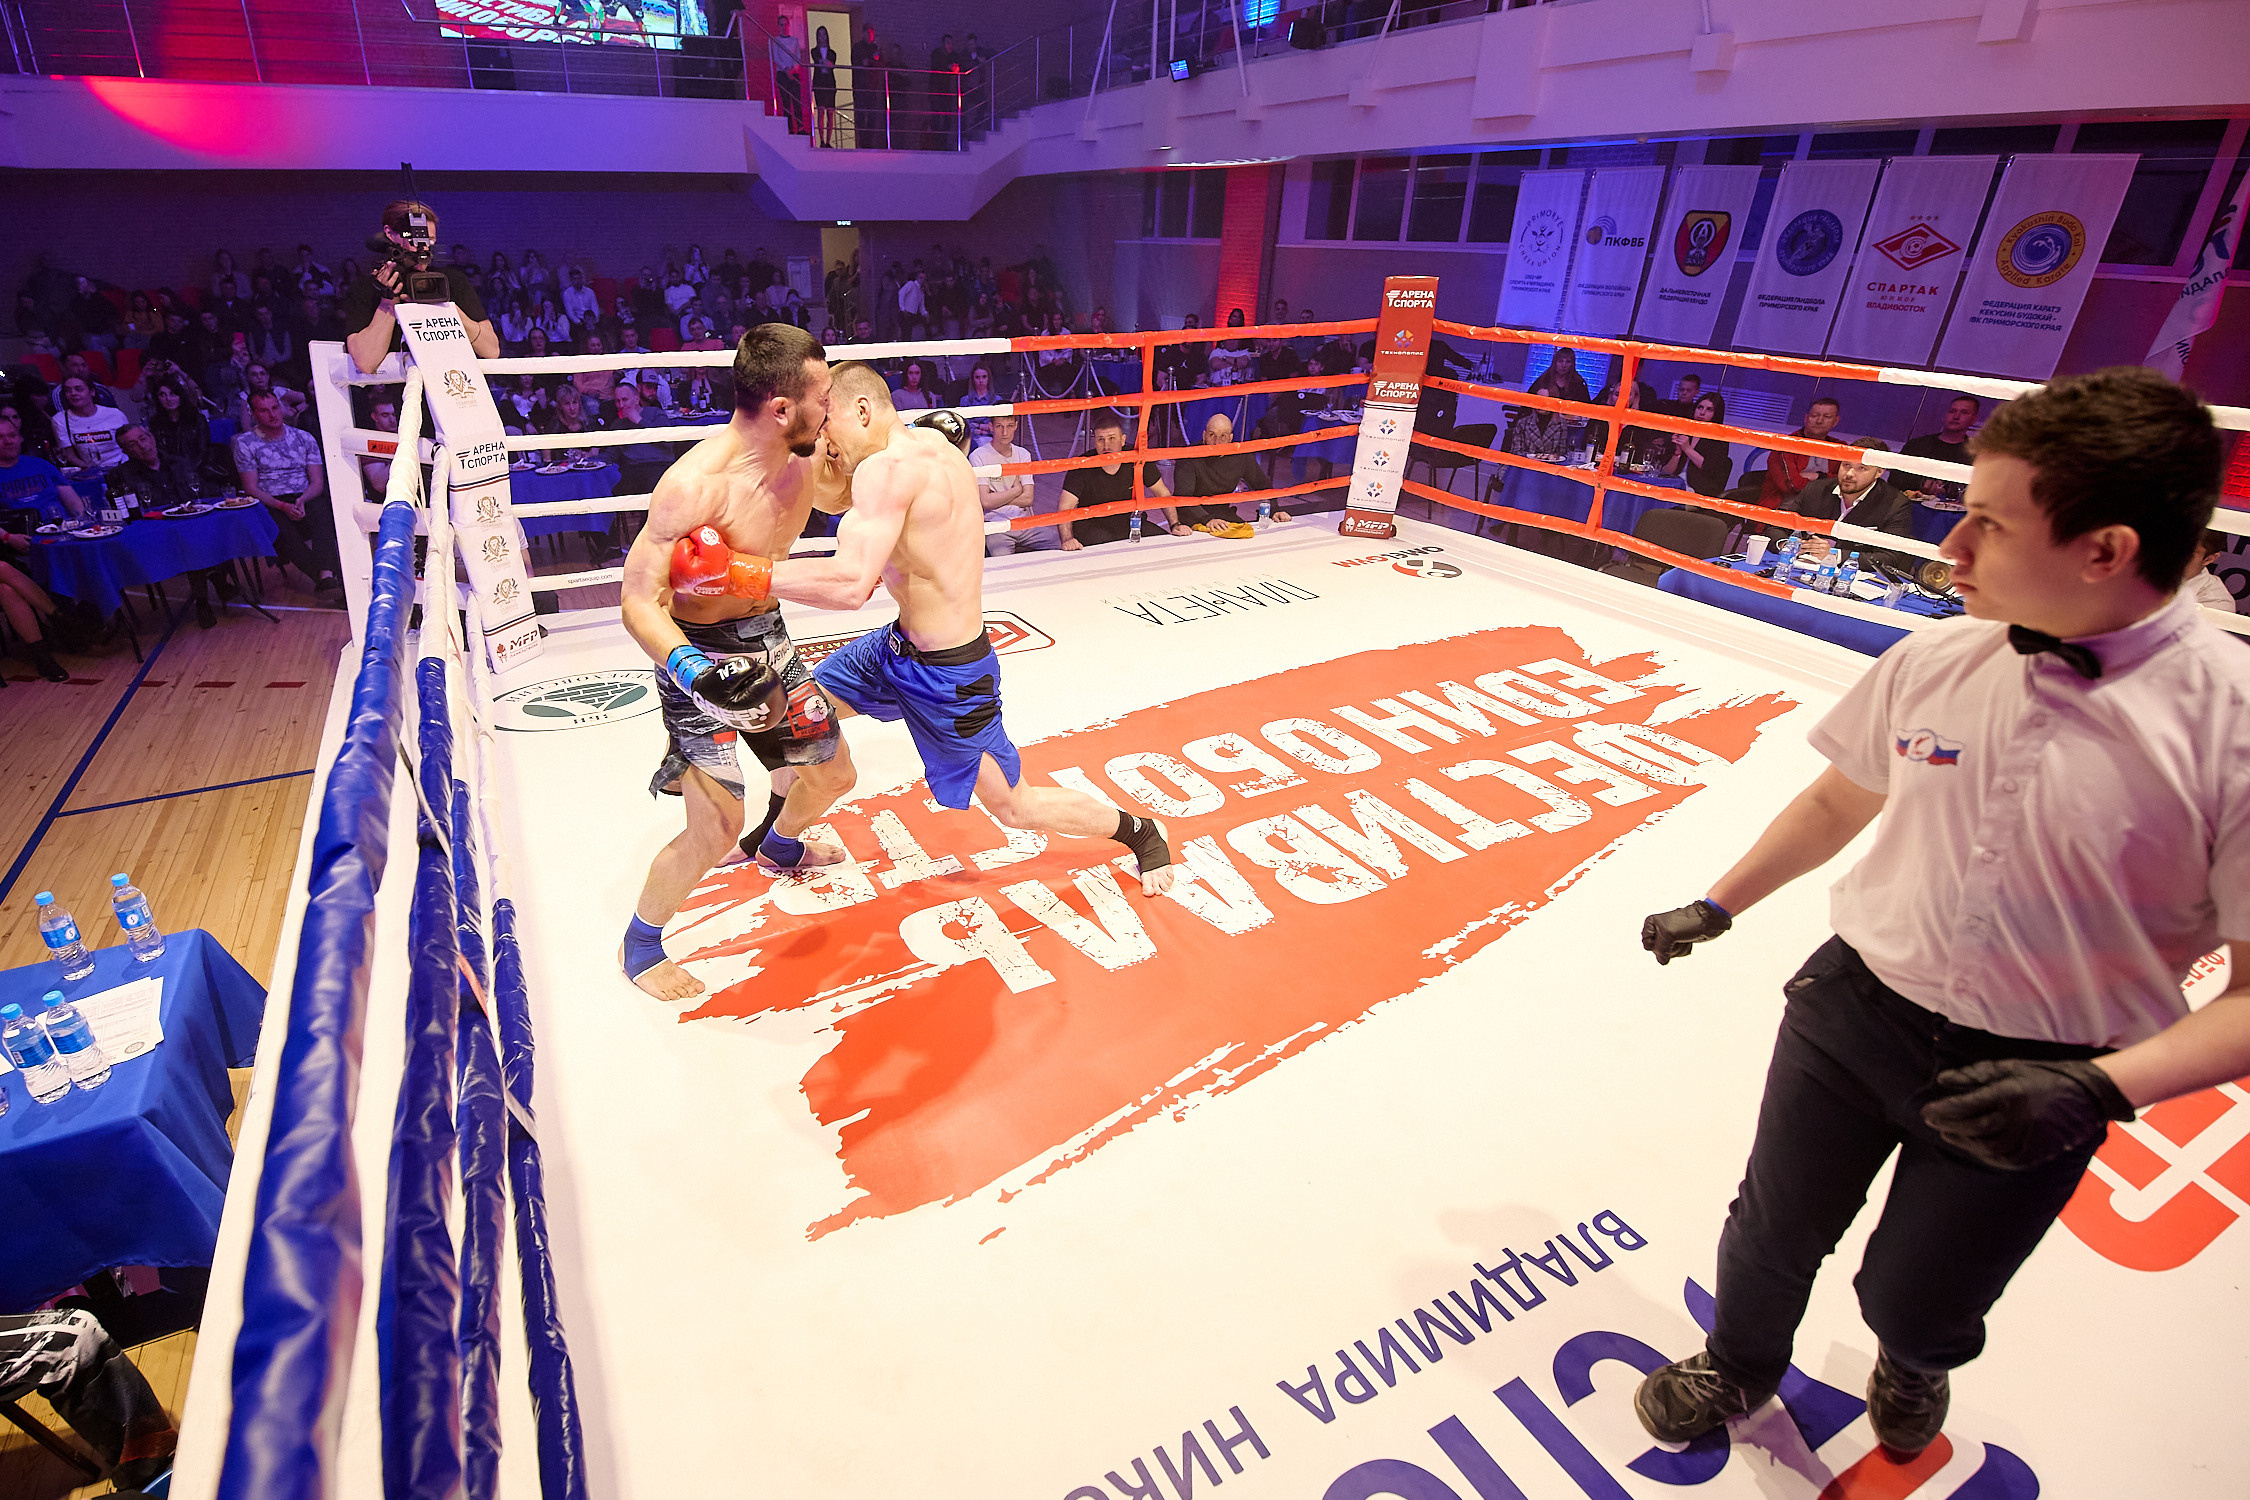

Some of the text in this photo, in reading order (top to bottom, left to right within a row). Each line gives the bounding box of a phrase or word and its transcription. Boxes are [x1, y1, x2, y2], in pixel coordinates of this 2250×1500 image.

[2006, 214, 2082, 247] Kyokushin Budo Kai
[1604, 237, 1645, 247] ПКФВБ
[2001, 260, 2071, 285] Applied Karate
[1400, 290, 1435, 299] АРЕНА
[1659, 287, 1711, 298] ДАЛЬНЕВОСТОЧНАЯ
[1866, 281, 1940, 296] СПАРТАК
[1393, 299, 1434, 309] СПОРТА
[1757, 293, 1794, 303] ФЕДЕРАЦИЯ
[1758, 302, 1803, 311] ПРИМОРСКОГО
[1865, 302, 1927, 313] ВЛАДИВОСТОК
[1982, 300, 2061, 313] ФЕДЕРАЦИЯ КАРАТЭ
[1979, 308, 2016, 318] КЕКУСИН
[2016, 311, 2053, 321] БУДОКАЙ
[425, 317, 461, 329] АРЕНА
[1982, 317, 2040, 330] ПРИМОРСКОГО
[2040, 324, 2062, 332] КРАЯ
[423, 329, 466, 342] СПОРТА
[1387, 381, 1420, 391] АРЕНА
[1379, 389, 1418, 399] СПОРТА
[473, 440, 506, 456] АРЕНА
[467, 453, 507, 469] СПОРТА
[1357, 520, 1390, 531] MFP
[1330, 546, 1444, 568] OMELGYM
[1113, 579, 1320, 627] ПЛАНЕТА
[509, 629, 538, 651] MFP
[795, 640, 851, 654] МАГАЗИ
[715, 659, 751, 681] IDEAL
[898, 720, 1733, 995] ФЕСТИВАЛЬ
[1276, 1209, 1648, 1424] ВЛАДИМИРА
